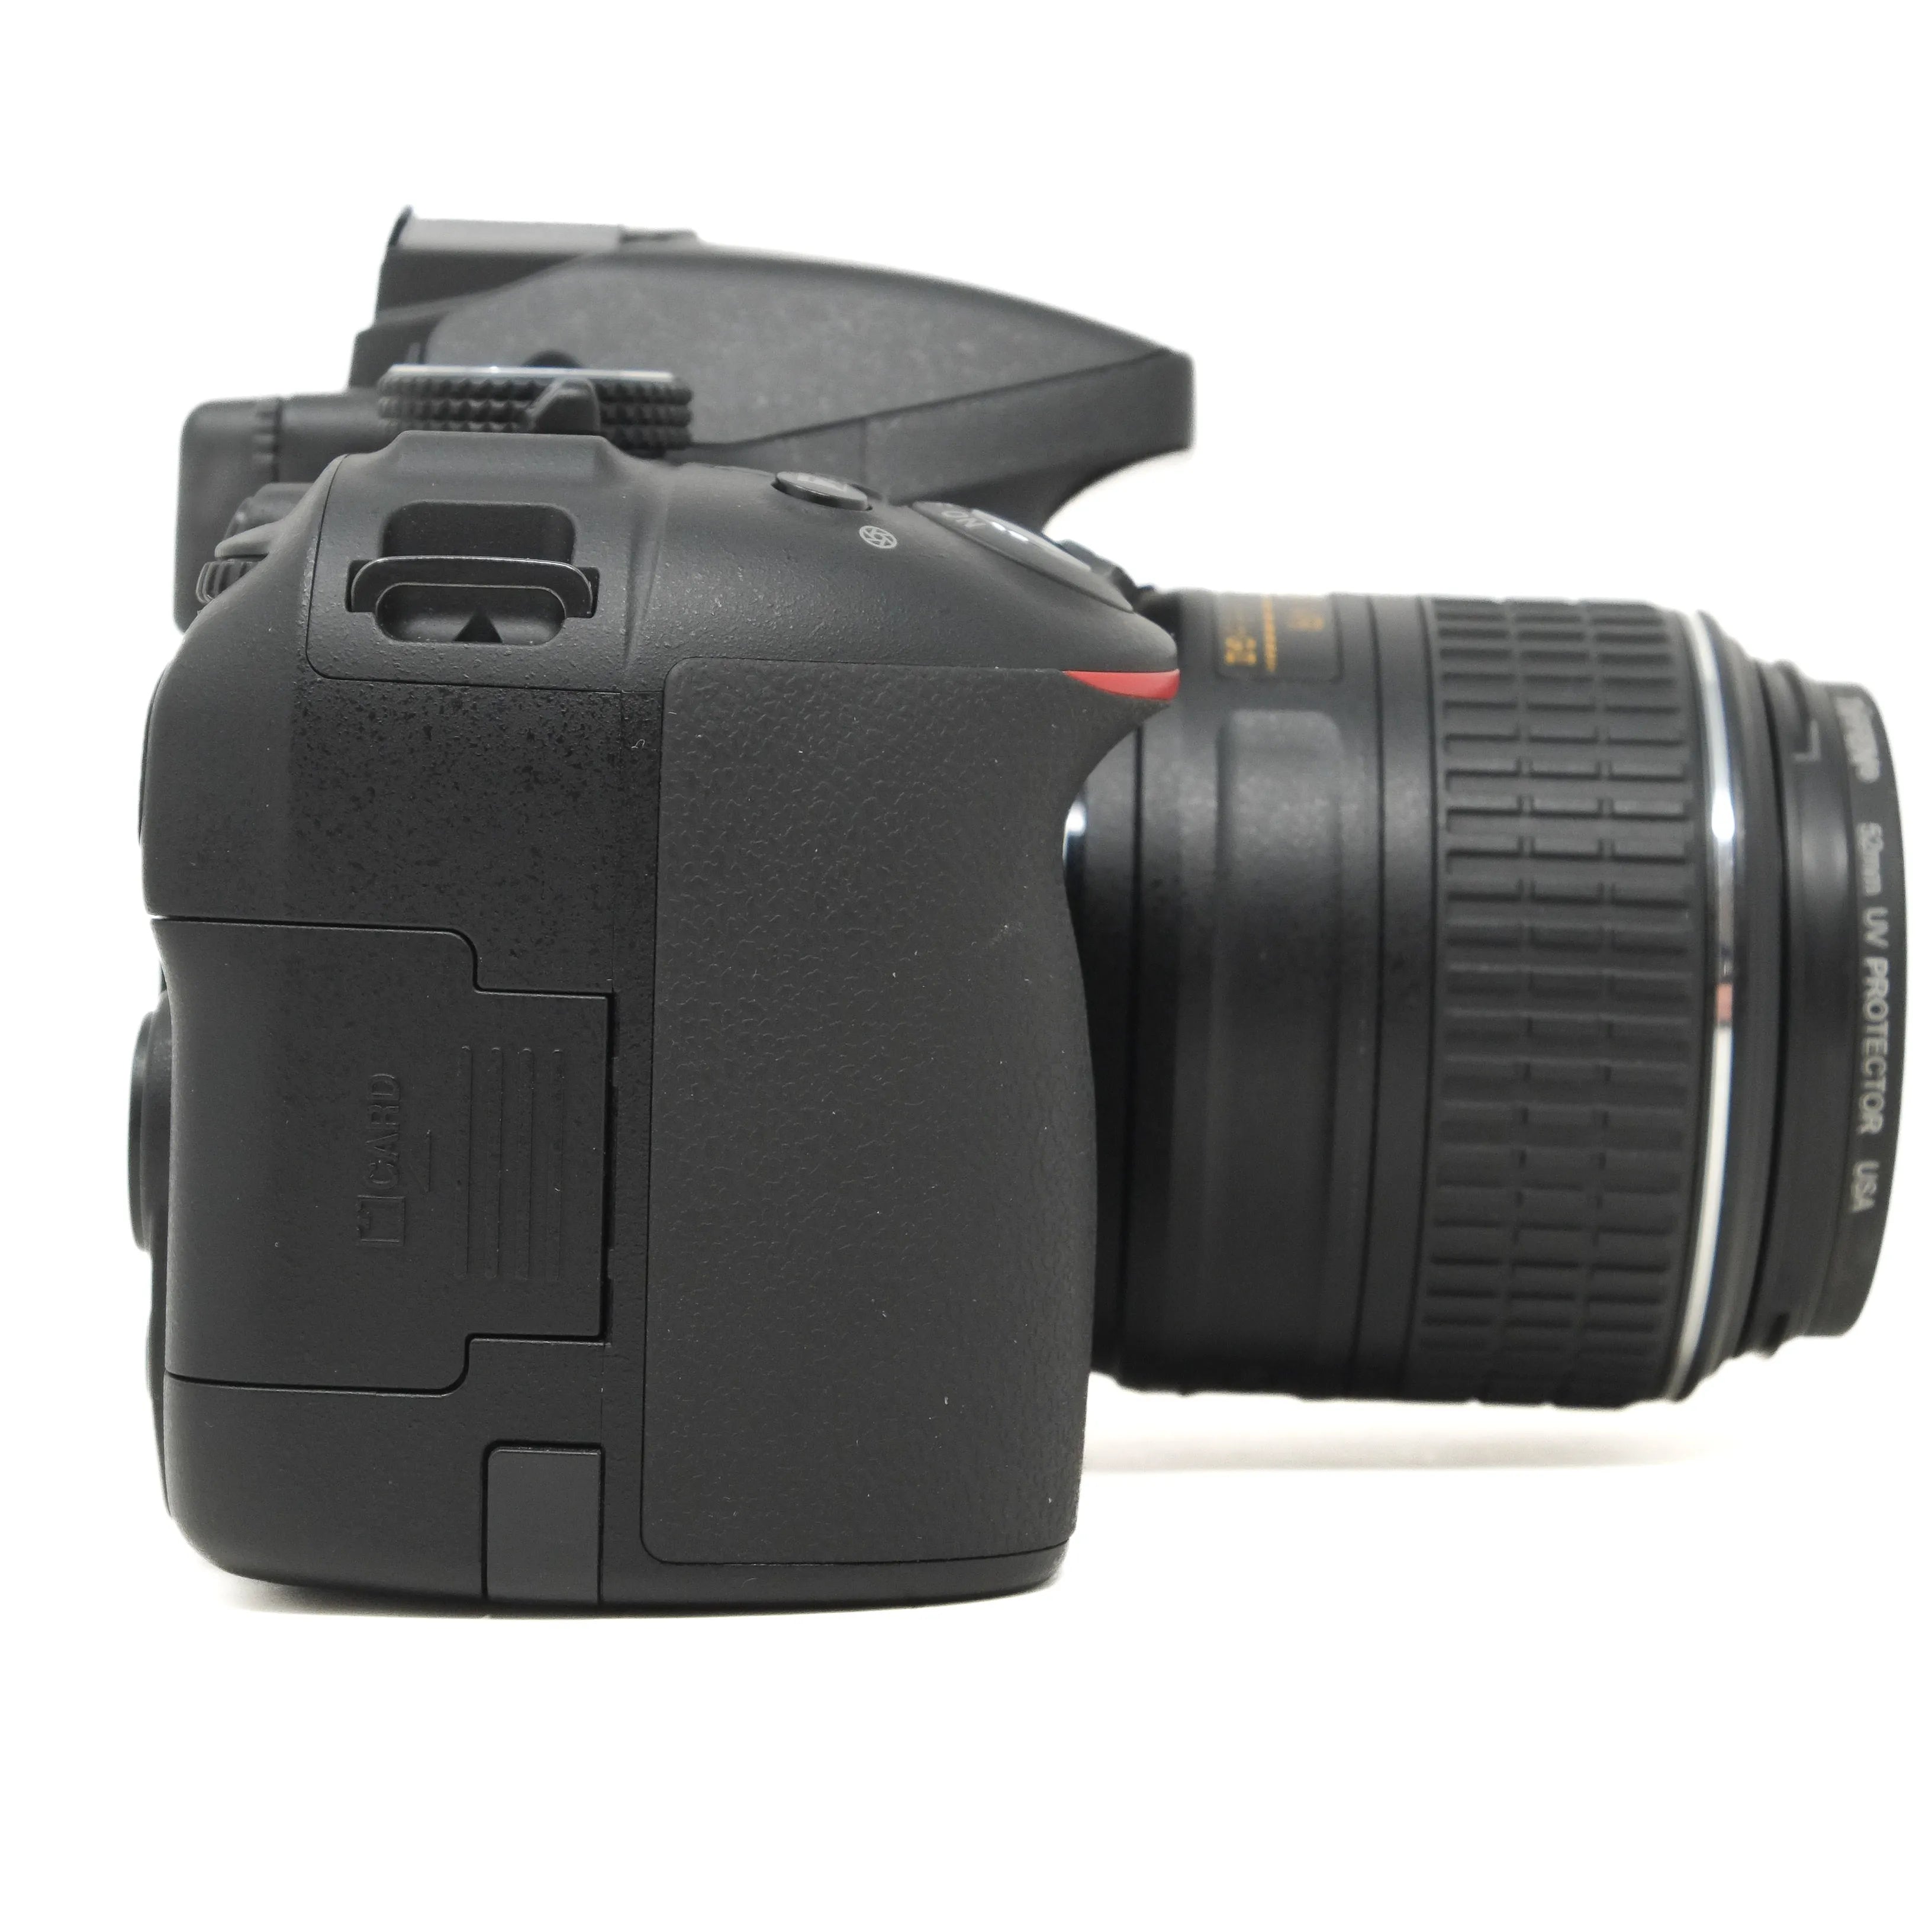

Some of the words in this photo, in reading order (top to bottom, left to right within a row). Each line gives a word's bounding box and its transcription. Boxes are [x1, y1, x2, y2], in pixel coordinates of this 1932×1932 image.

[941, 510, 986, 528] ON
[1855, 822, 1883, 896] 52mm
[1862, 907, 1889, 948] UV
[1857, 956, 1889, 1134] PROTECTOR
[365, 1073, 400, 1189] CARD
[1850, 1160, 1880, 1213] USA
